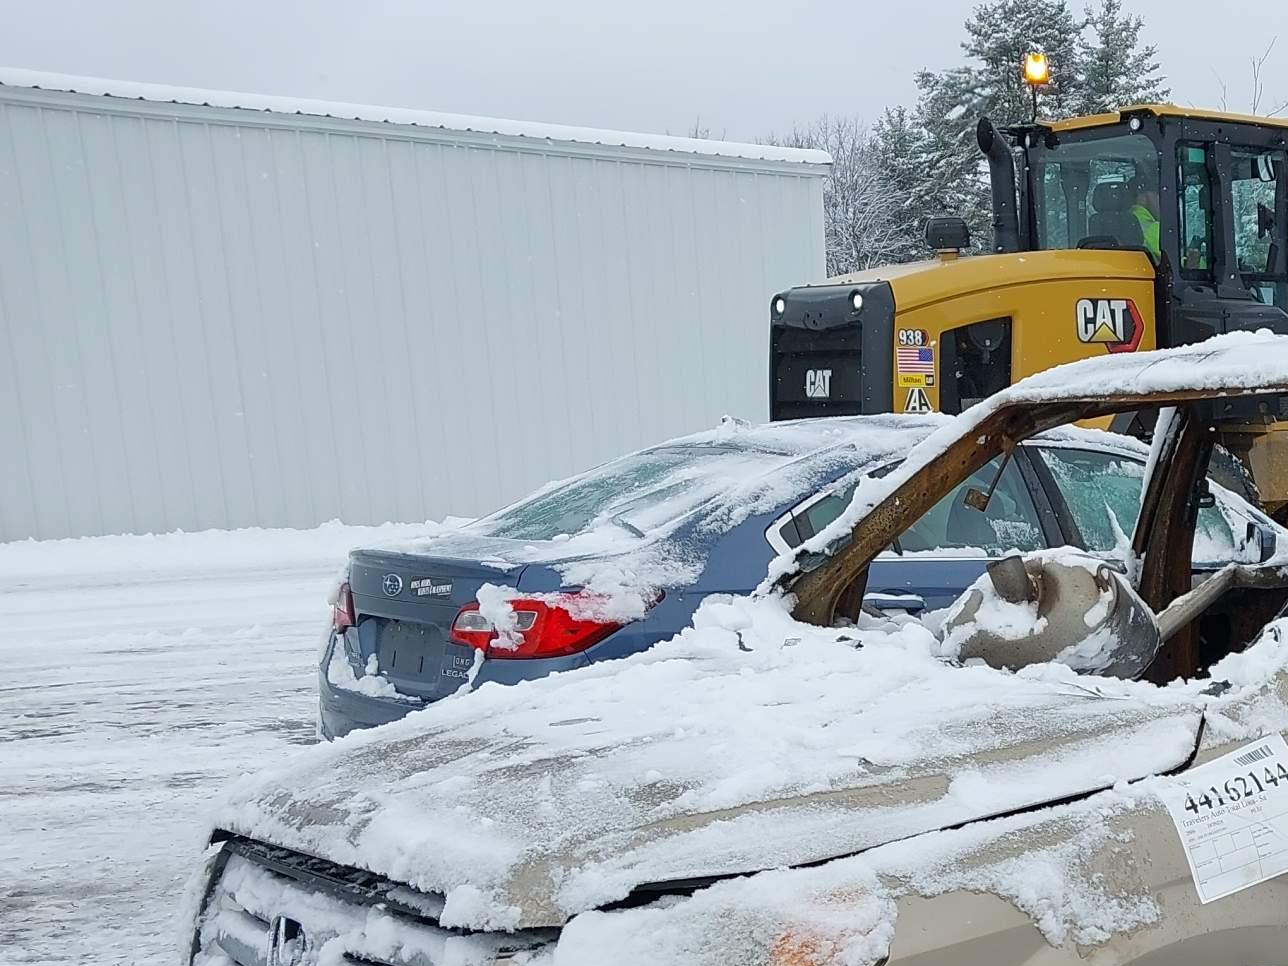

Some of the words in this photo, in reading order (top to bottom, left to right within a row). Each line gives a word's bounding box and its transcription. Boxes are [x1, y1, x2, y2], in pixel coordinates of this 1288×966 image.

[1077, 299, 1127, 342] CAT
[899, 329, 923, 346] 938
[806, 369, 832, 398] CAT
[441, 669, 469, 679] LEGAC
